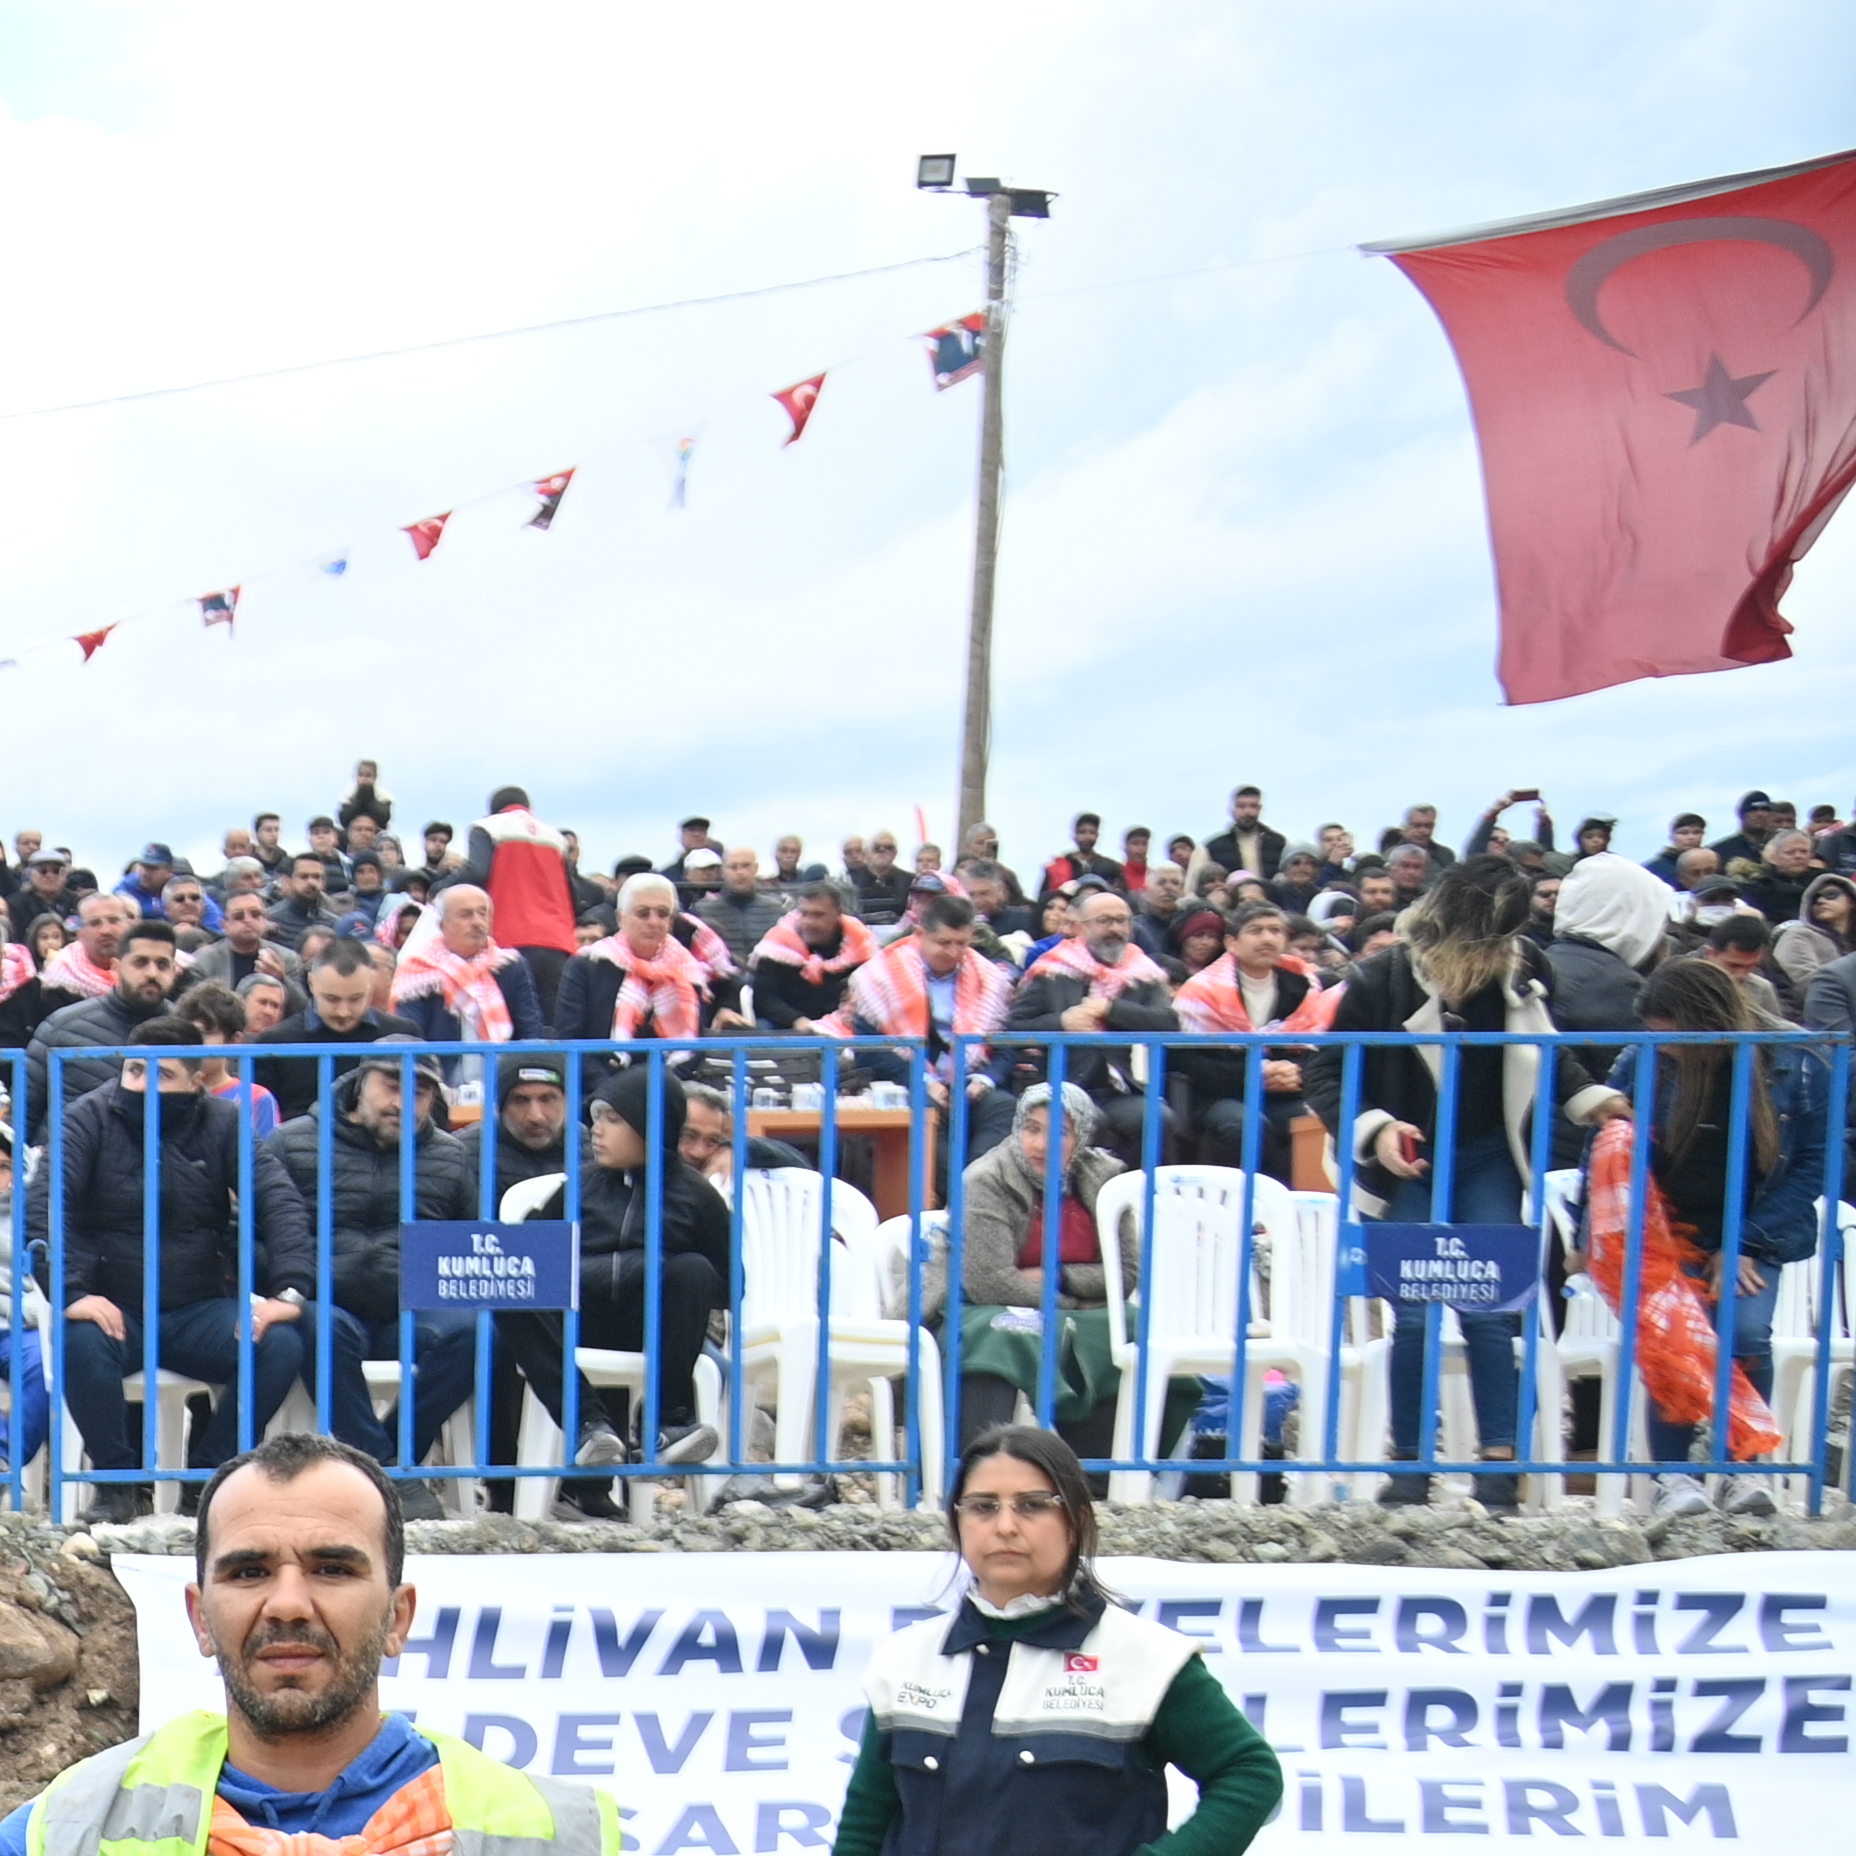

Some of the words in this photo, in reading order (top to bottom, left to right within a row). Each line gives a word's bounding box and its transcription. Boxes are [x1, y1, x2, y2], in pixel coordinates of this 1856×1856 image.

[470, 1233, 504, 1255] T.C.
[1434, 1237, 1469, 1258] T.C.
[437, 1255, 536, 1277] KUMLUCA
[1399, 1259, 1500, 1282] KUMLUCA
[437, 1276, 535, 1299] BELEDİYESİ
[1398, 1281, 1500, 1302] BELEDİYESİ
[897, 1691, 937, 1709] EXPO
[1045, 1685, 1105, 1698] KUMLUCA
[460, 1706, 793, 1776] DEVE
